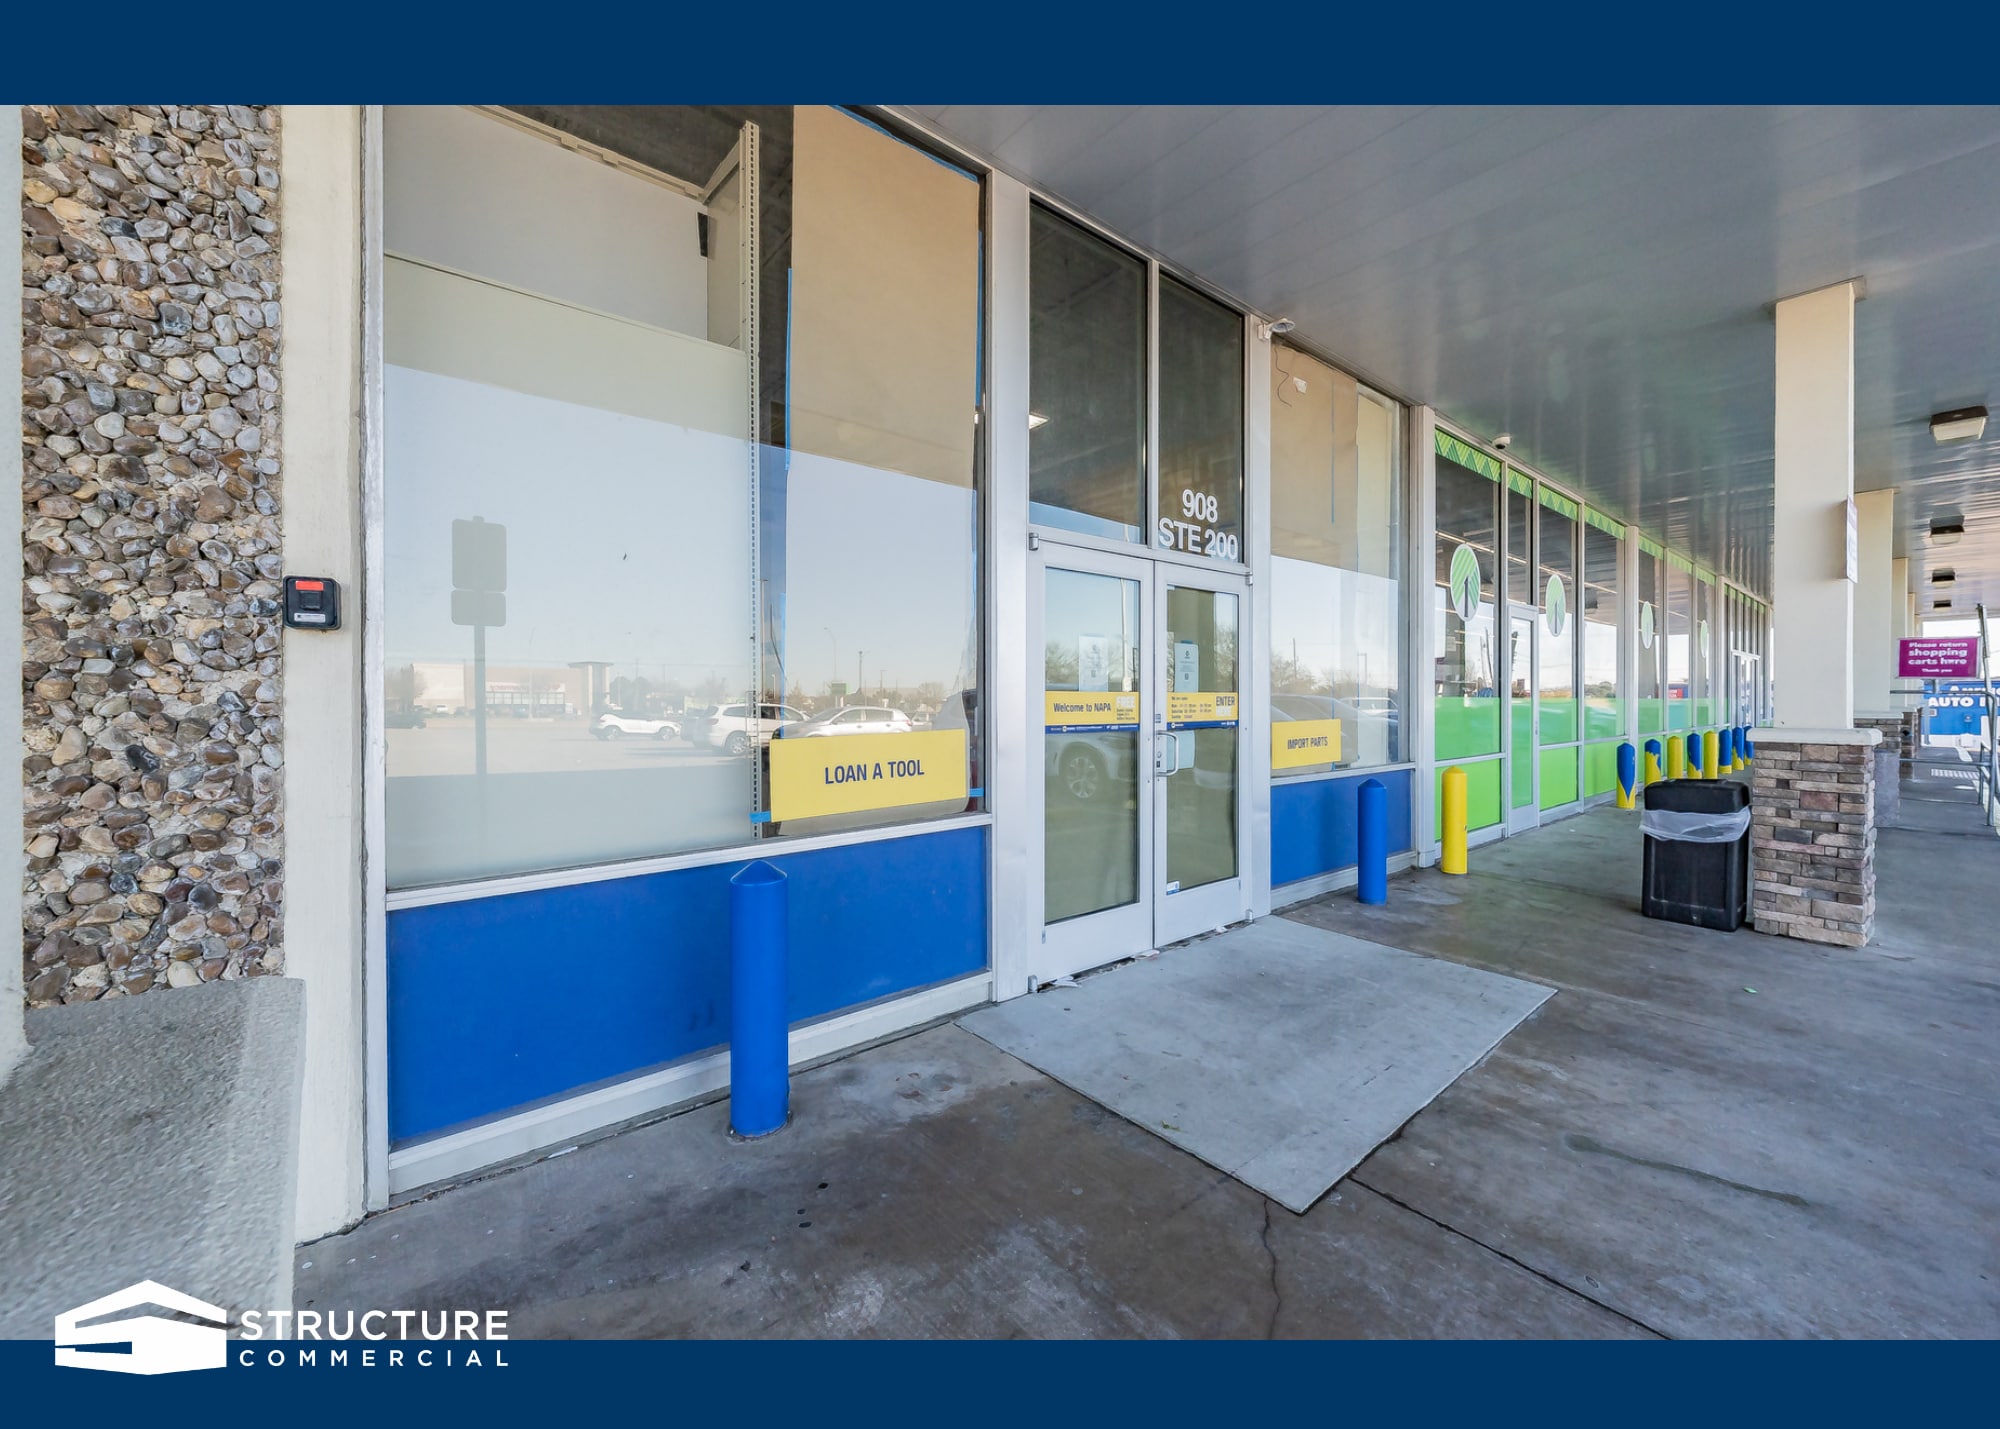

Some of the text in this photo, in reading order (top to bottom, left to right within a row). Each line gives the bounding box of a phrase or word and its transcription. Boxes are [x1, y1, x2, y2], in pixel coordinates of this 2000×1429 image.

[1182, 489, 1218, 523] 908
[1159, 517, 1238, 560] STE 200
[1909, 648, 1968, 657] shopping
[1940, 657, 1967, 665] here
[1216, 696, 1236, 706] ENTER
[1928, 697, 1975, 708] AUTO
[1053, 703, 1112, 713] Welcome to NAPA
[1287, 736, 1329, 750] IMPORT PARTS
[824, 759, 926, 785] LOAN A TOOL
